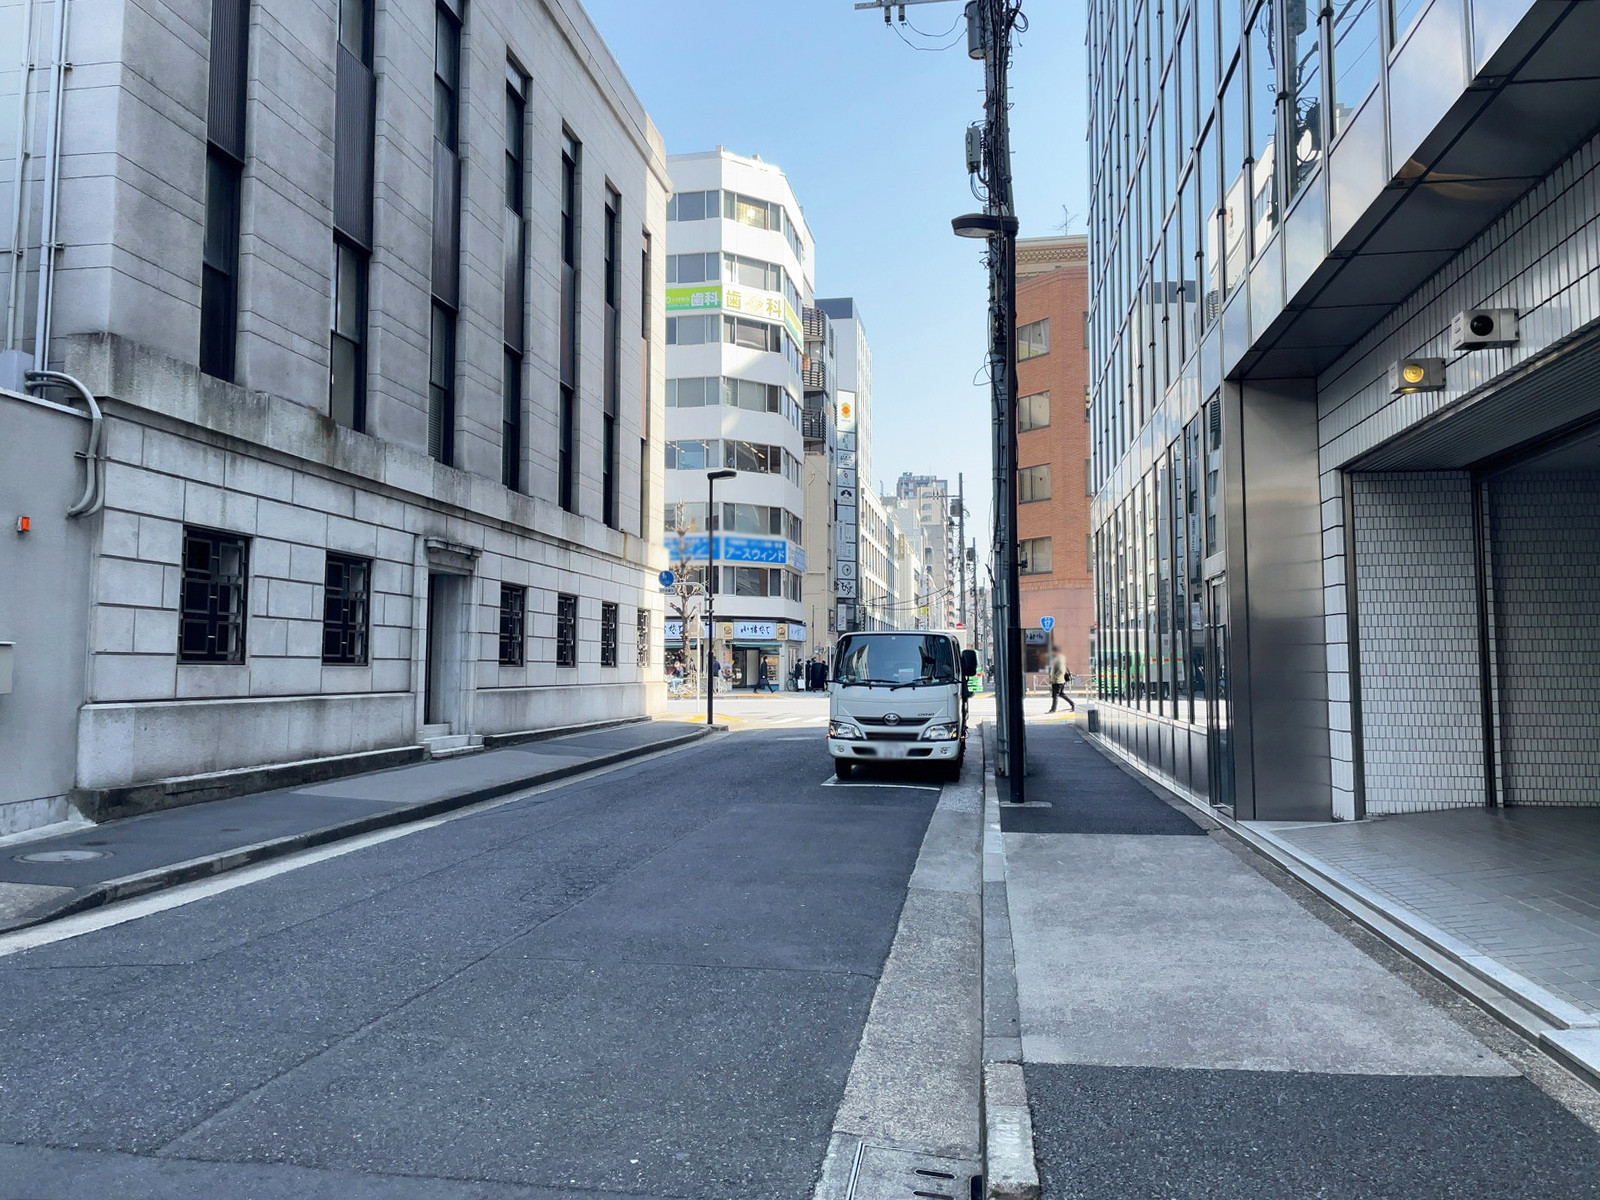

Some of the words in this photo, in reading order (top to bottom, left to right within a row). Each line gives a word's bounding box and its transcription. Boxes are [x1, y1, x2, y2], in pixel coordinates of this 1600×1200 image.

[691, 291, 718, 307] 歯科
[726, 547, 785, 562] アースウィンド
